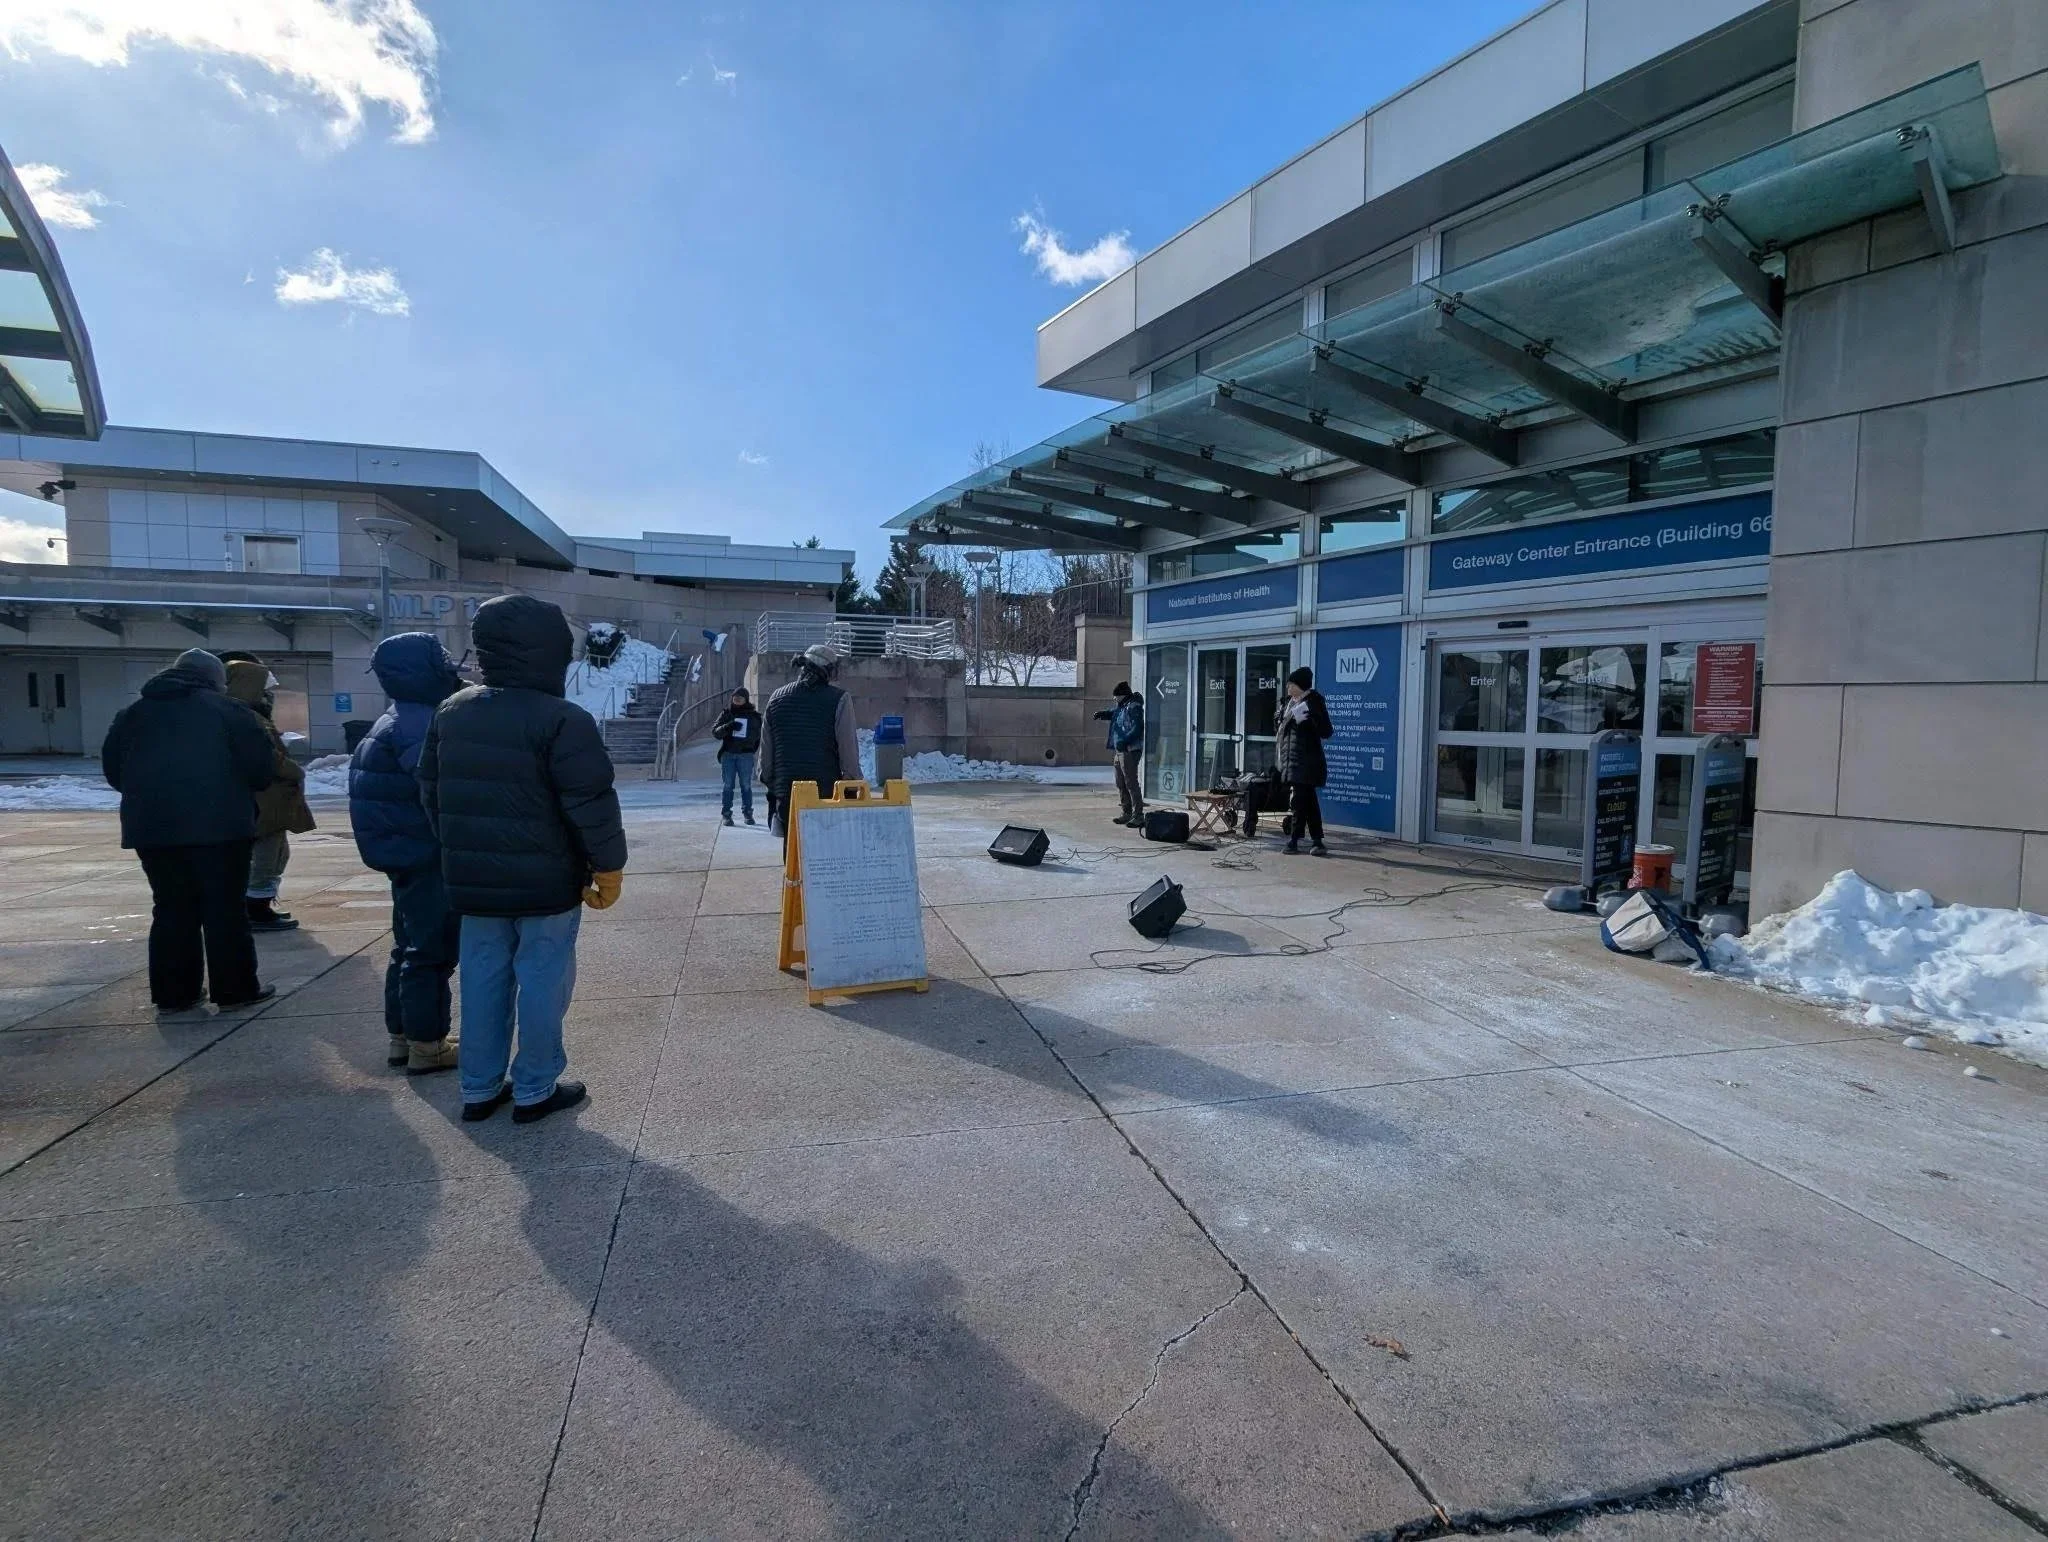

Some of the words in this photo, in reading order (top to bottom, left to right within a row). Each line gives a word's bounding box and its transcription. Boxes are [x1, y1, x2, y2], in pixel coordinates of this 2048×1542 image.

[1452, 550, 1513, 570] Gateway
[1517, 544, 1570, 562] Center
[1574, 533, 1651, 555] Entrance
[1656, 520, 1743, 548] (Building
[1168, 597, 1197, 608] National
[1198, 591, 1232, 604] Institutes
[1233, 589, 1242, 600] of
[1243, 585, 1270, 598] Health
[388, 594, 455, 621] MLP
[1340, 657, 1367, 674] NIH
[1209, 680, 1226, 690] Exit
[1258, 678, 1276, 689] Exit
[1470, 676, 1497, 686] Enter
